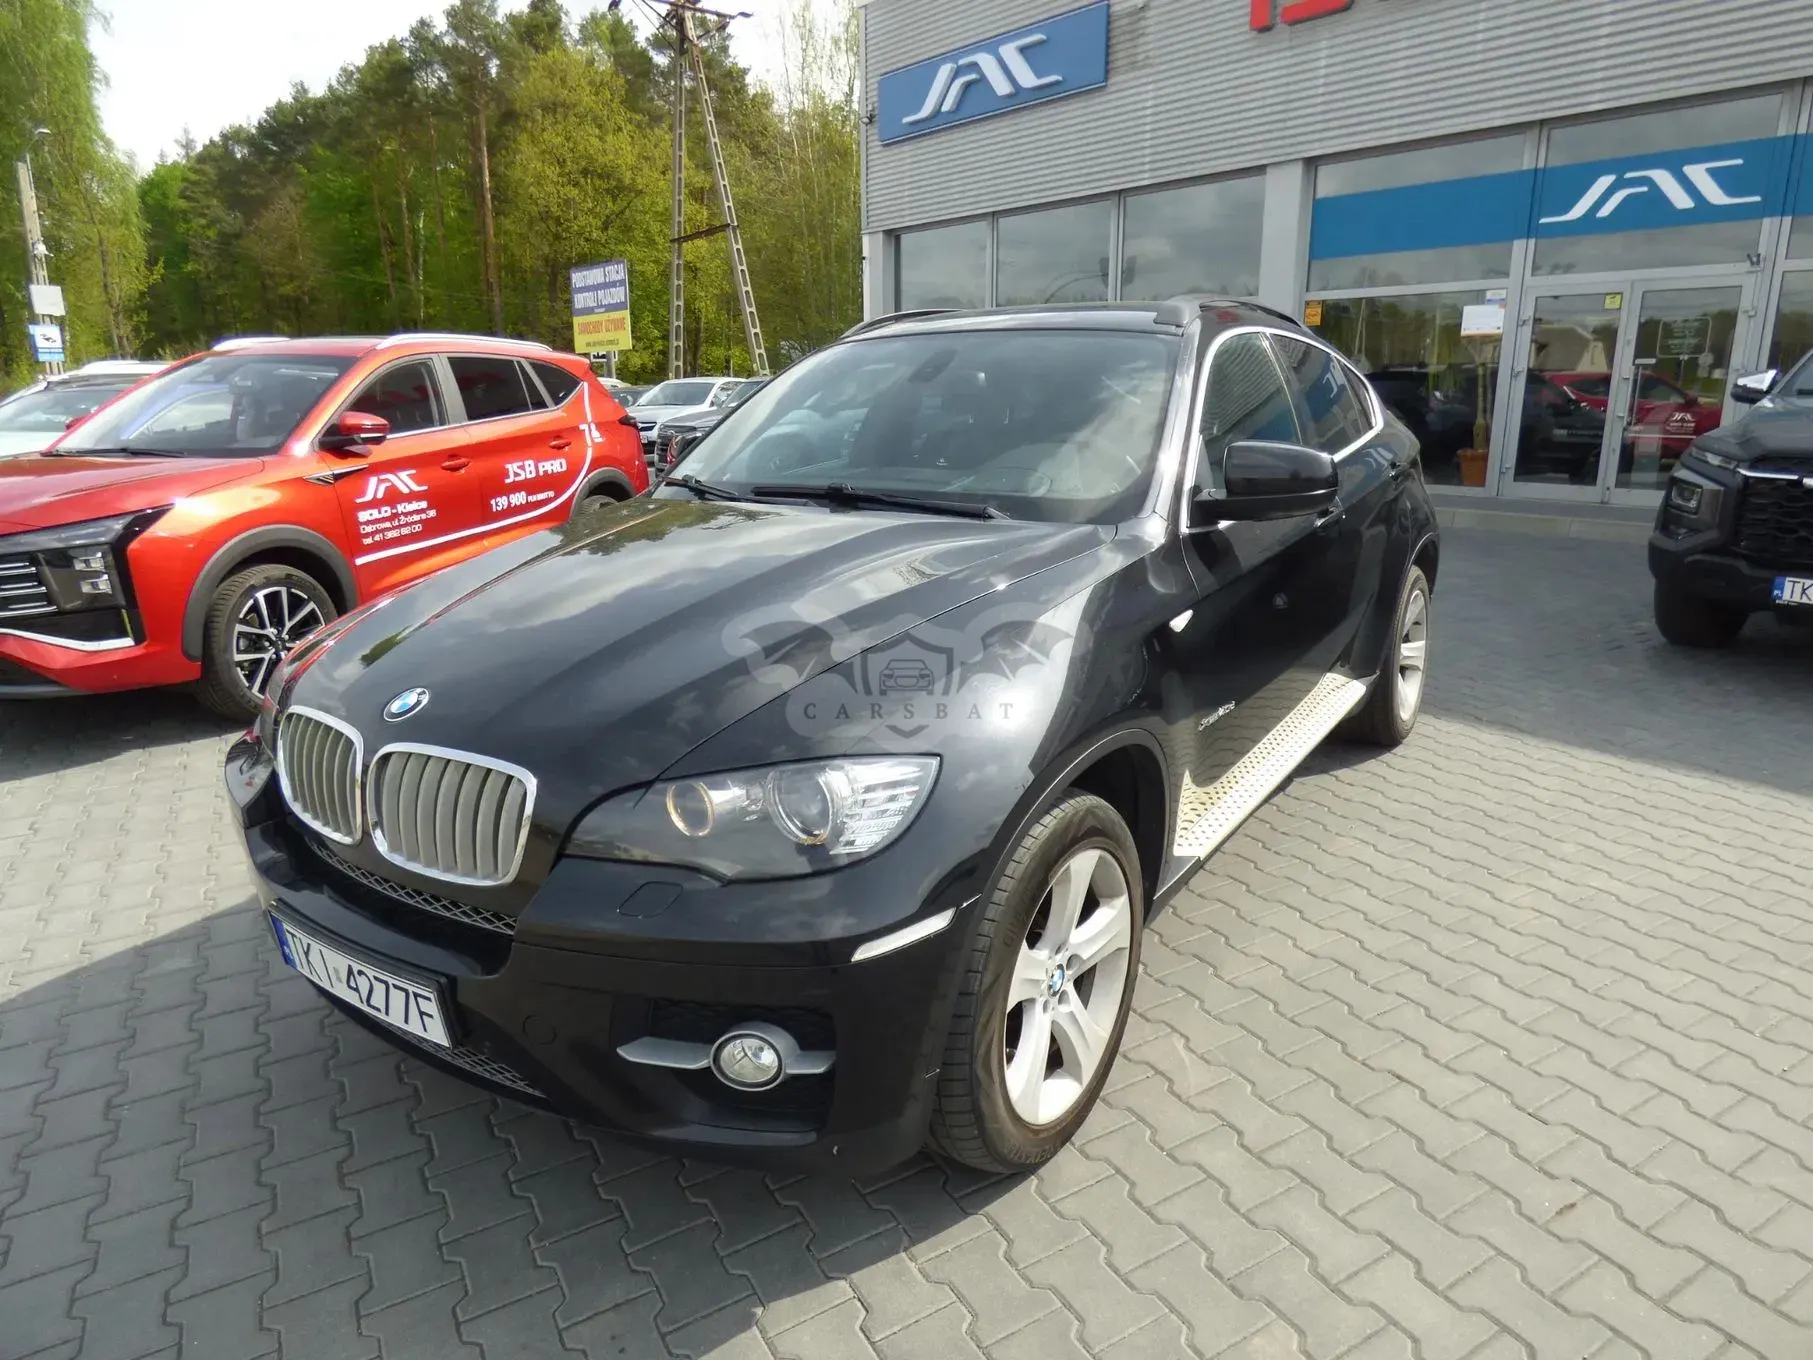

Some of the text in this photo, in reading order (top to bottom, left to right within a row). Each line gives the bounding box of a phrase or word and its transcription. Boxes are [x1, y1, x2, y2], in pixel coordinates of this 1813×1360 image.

[902, 33, 1064, 124] JAC
[1538, 158, 1761, 224] JAC
[538, 458, 567, 476] PRO
[355, 469, 428, 503] JAC
[490, 495, 508, 512] 139
[509, 491, 526, 507] 900
[357, 507, 391, 522] SOLO
[396, 500, 428, 514] Kielce
[346, 963, 435, 1033] 4277F
